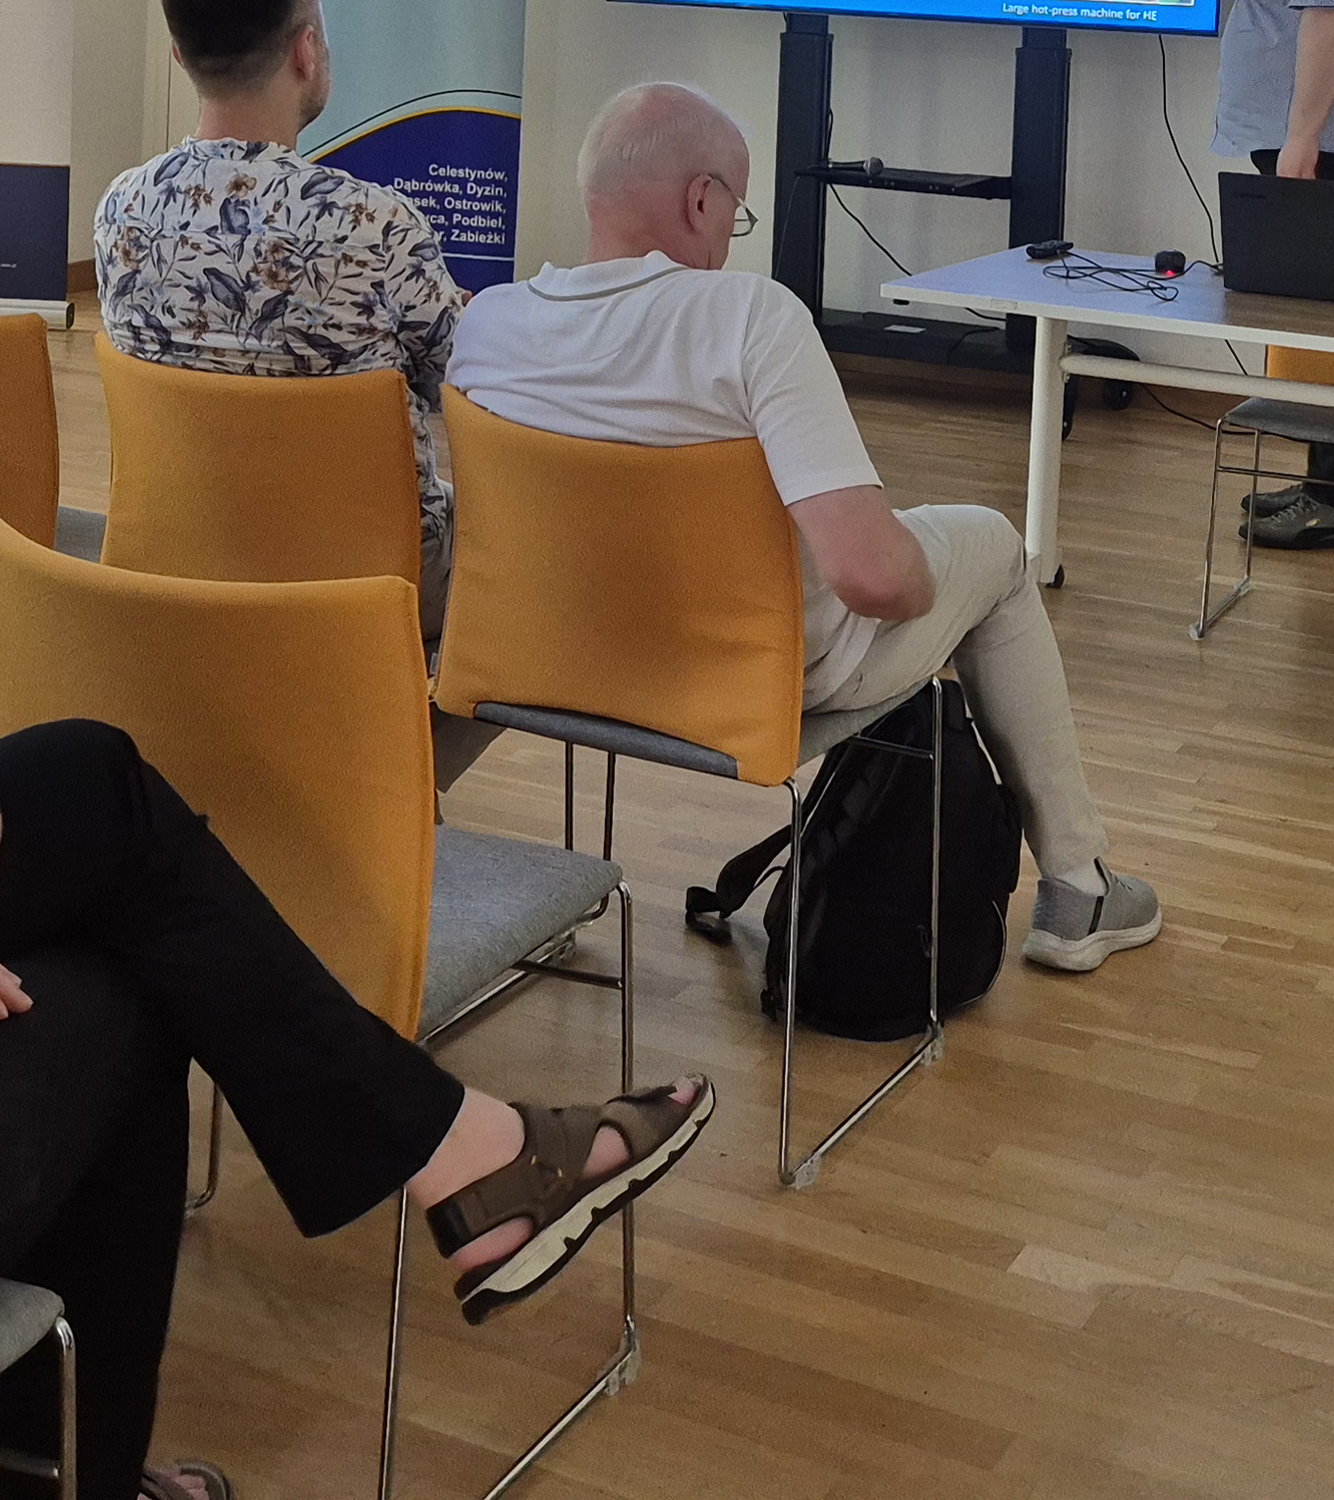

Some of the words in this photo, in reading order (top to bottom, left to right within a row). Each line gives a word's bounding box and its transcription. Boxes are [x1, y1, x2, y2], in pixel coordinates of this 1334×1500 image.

[1002, 2, 1029, 16] Large
[1031, 4, 1079, 17] hot-press
[1080, 6, 1124, 20] machine
[1125, 8, 1141, 20] for
[1142, 10, 1158, 21] HE
[428, 164, 508, 182] Celestynów,
[393, 177, 463, 195] Dąbrówka,
[467, 182, 507, 198] Dyzin,
[444, 197, 507, 213] Ostrowik,
[452, 213, 506, 229] Podbiel,
[450, 229, 506, 244] Zabieżki
